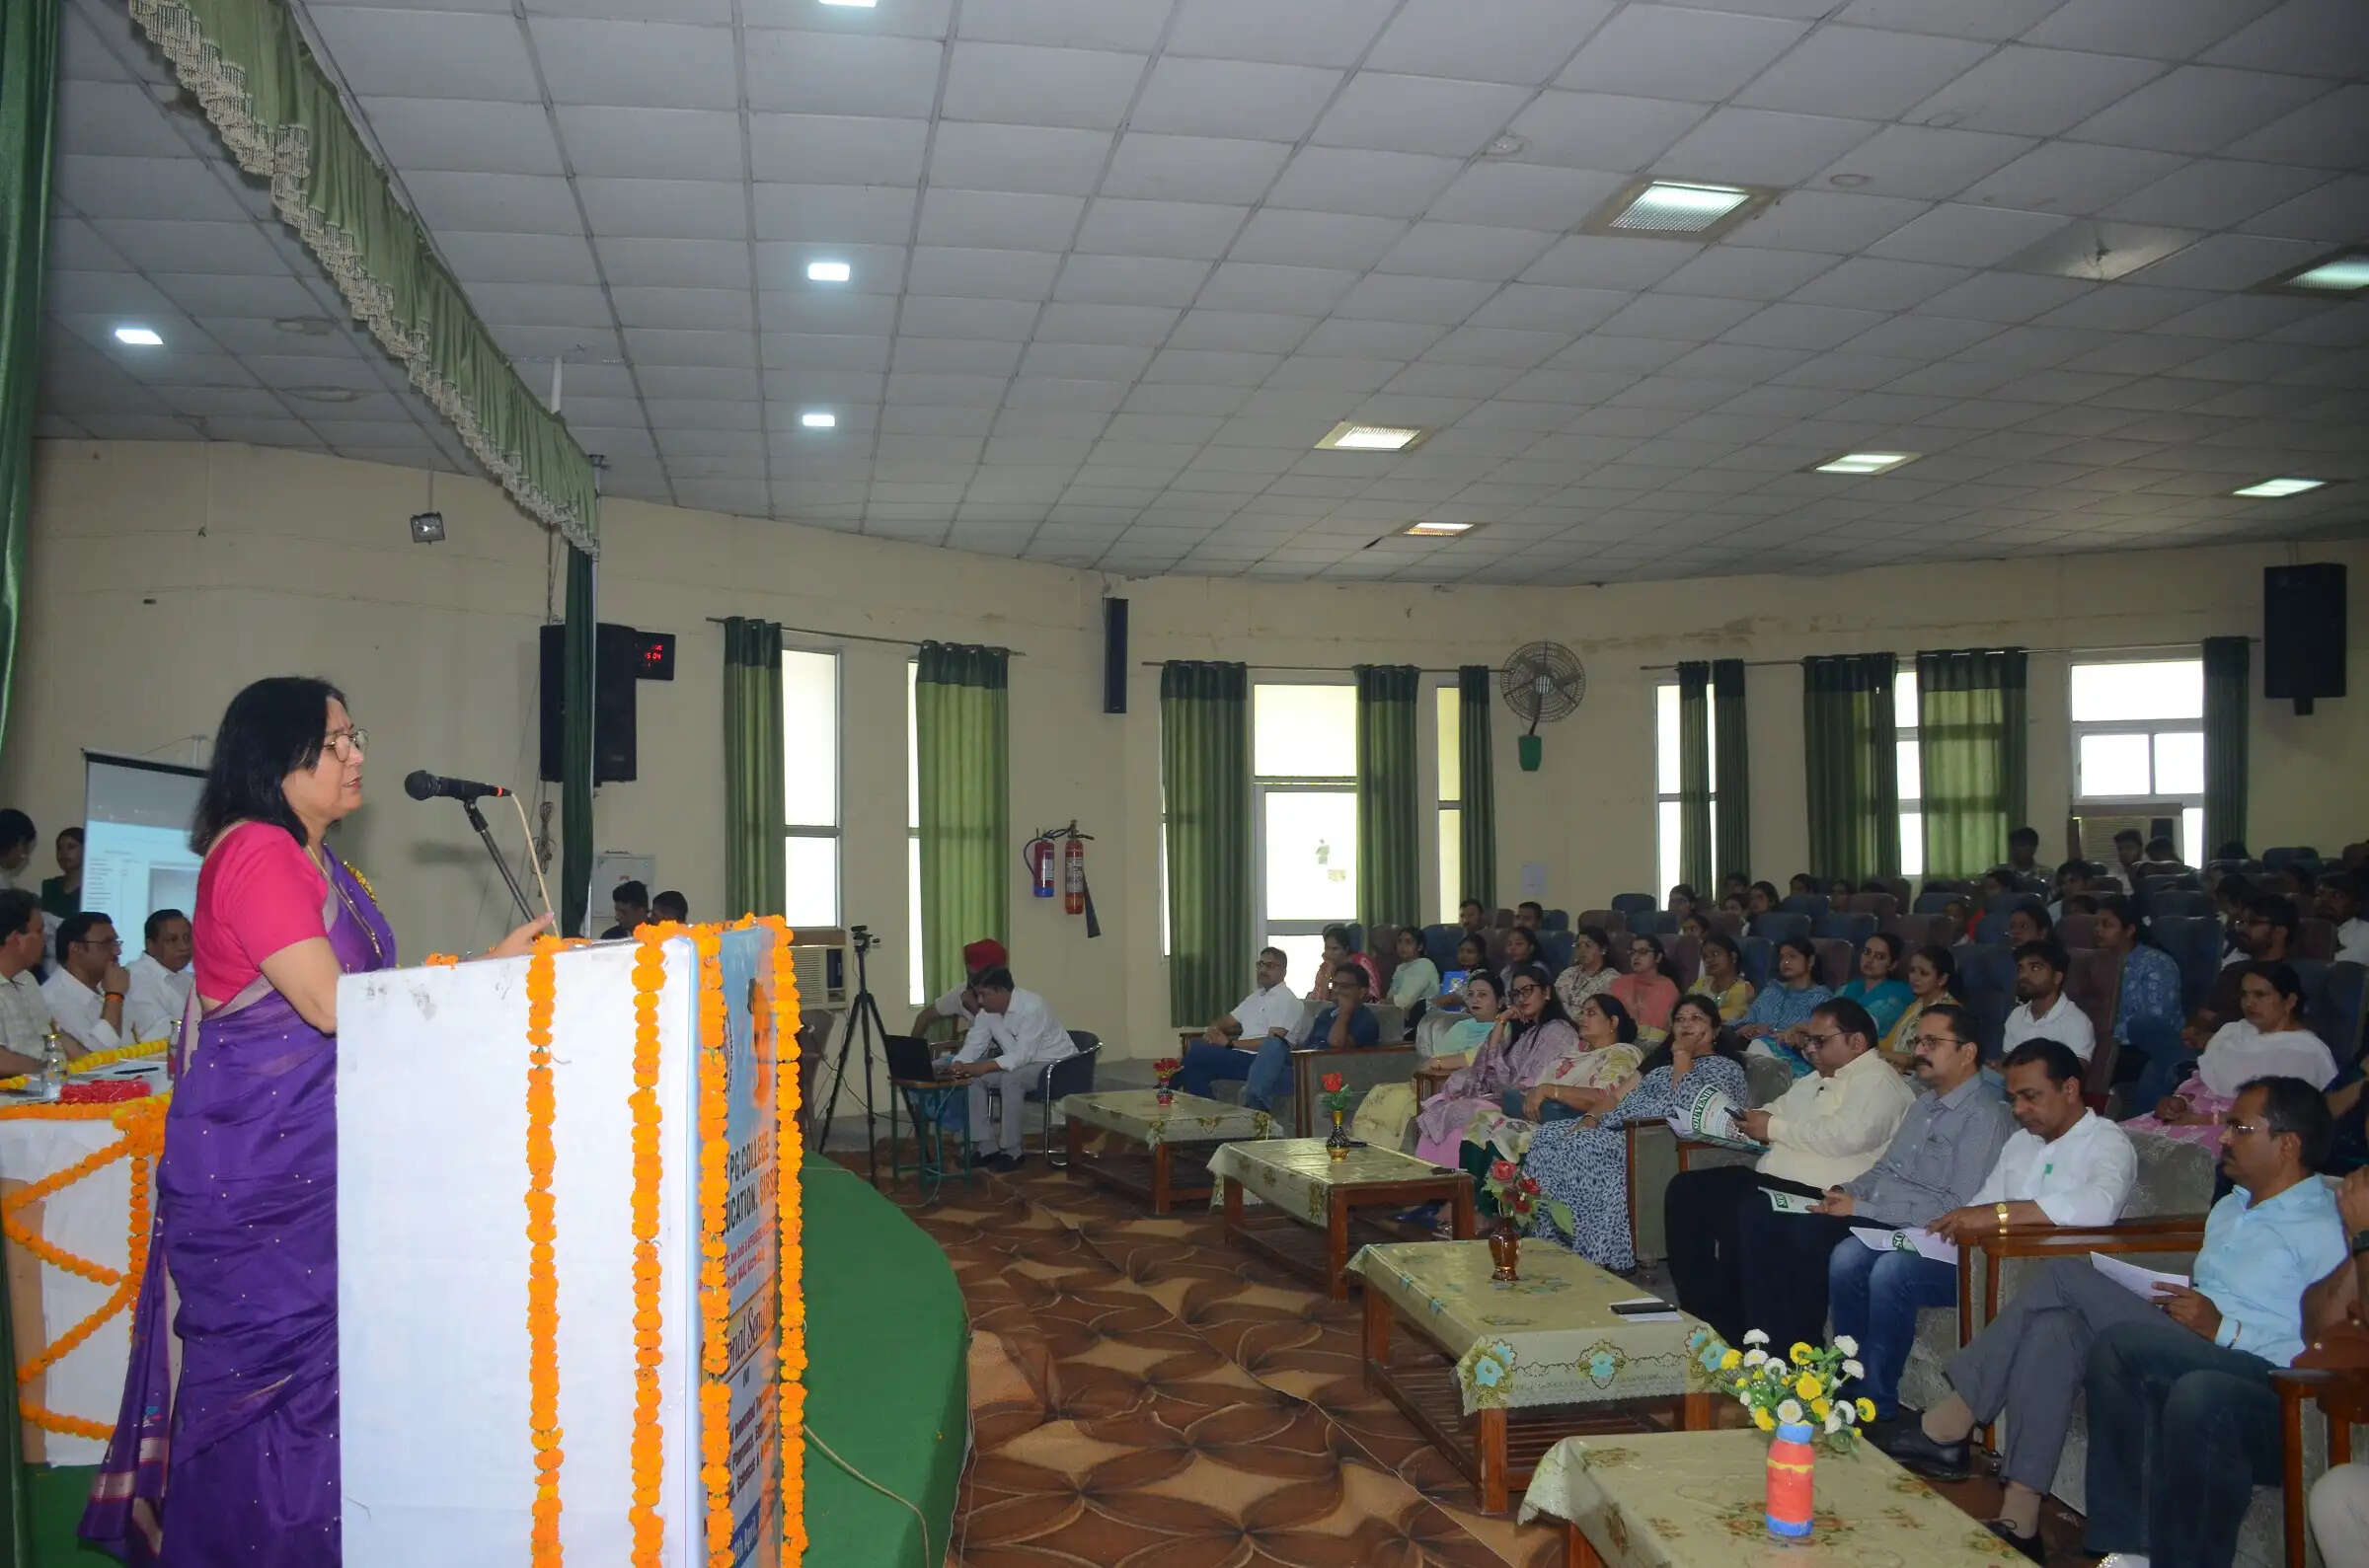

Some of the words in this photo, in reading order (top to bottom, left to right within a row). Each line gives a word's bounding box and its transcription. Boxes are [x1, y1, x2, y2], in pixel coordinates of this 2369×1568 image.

[1692, 1086, 1716, 1130] SOUVENIR
[729, 1151, 739, 1187] PG
[726, 1183, 758, 1232] UCATION,
[1893, 1232, 1905, 1247] SO
